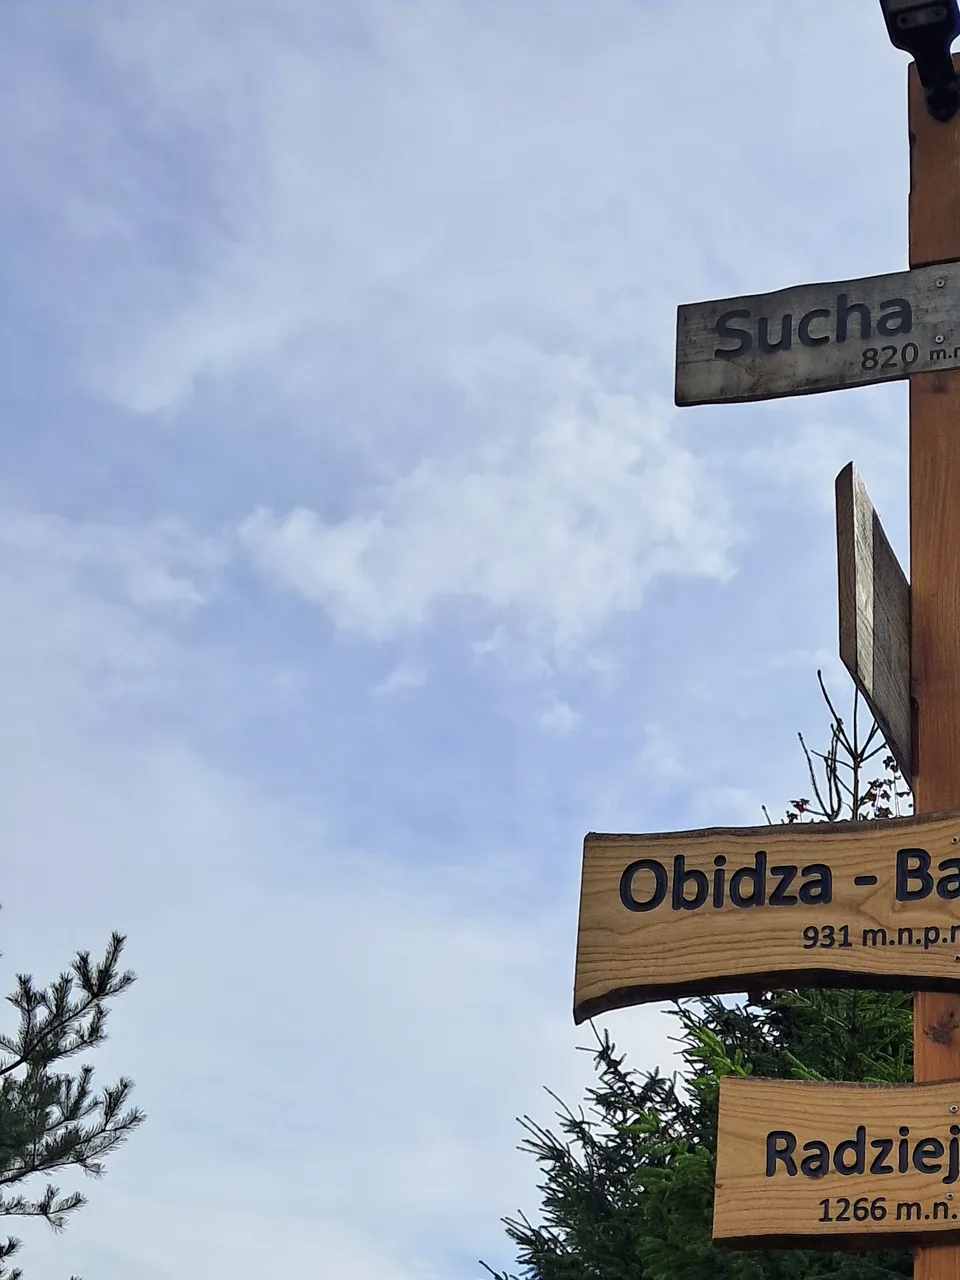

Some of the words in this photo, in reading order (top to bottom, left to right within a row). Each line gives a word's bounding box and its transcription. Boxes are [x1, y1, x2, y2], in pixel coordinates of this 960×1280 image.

[713, 293, 913, 360] Sucha
[861, 342, 919, 371] 820
[618, 850, 833, 913] Obidza
[853, 874, 877, 888] -
[802, 924, 853, 950] 931
[818, 1196, 888, 1223] 1266
